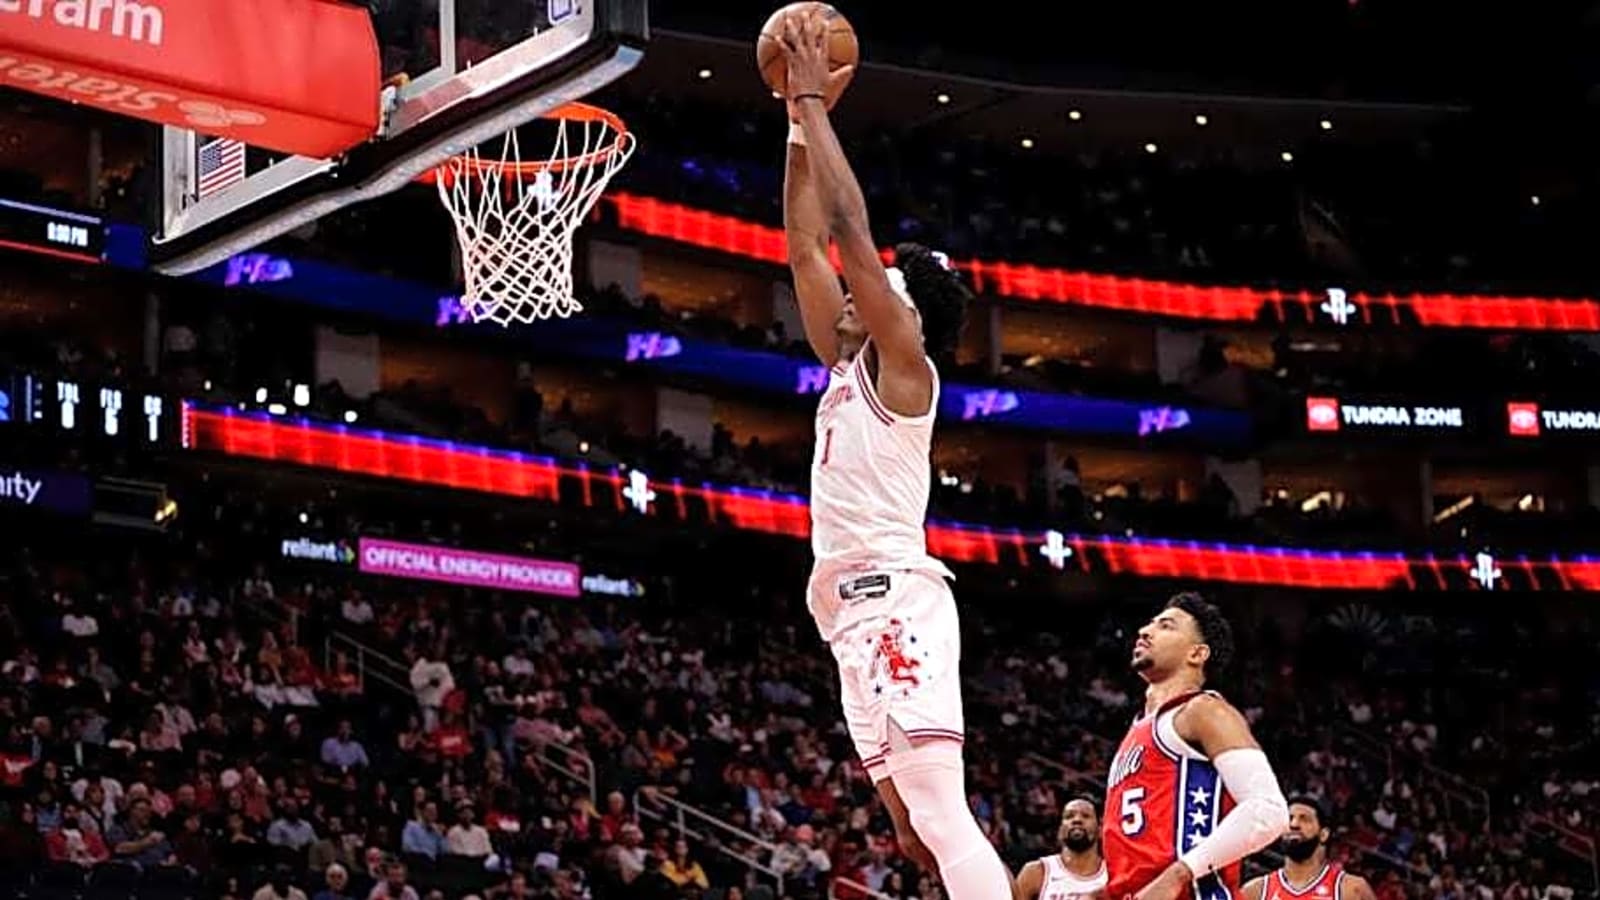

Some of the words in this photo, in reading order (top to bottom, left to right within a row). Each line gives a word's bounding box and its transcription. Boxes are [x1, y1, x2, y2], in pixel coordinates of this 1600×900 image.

[1341, 405, 1410, 425] TUNDRA
[1414, 407, 1462, 426] ZONE
[1541, 410, 1600, 429] TUNDR
[365, 547, 436, 571] OFFICIAL
[438, 555, 500, 579] ENERGY
[500, 563, 574, 589] PROVIDER
[1120, 786, 1146, 838] 5
